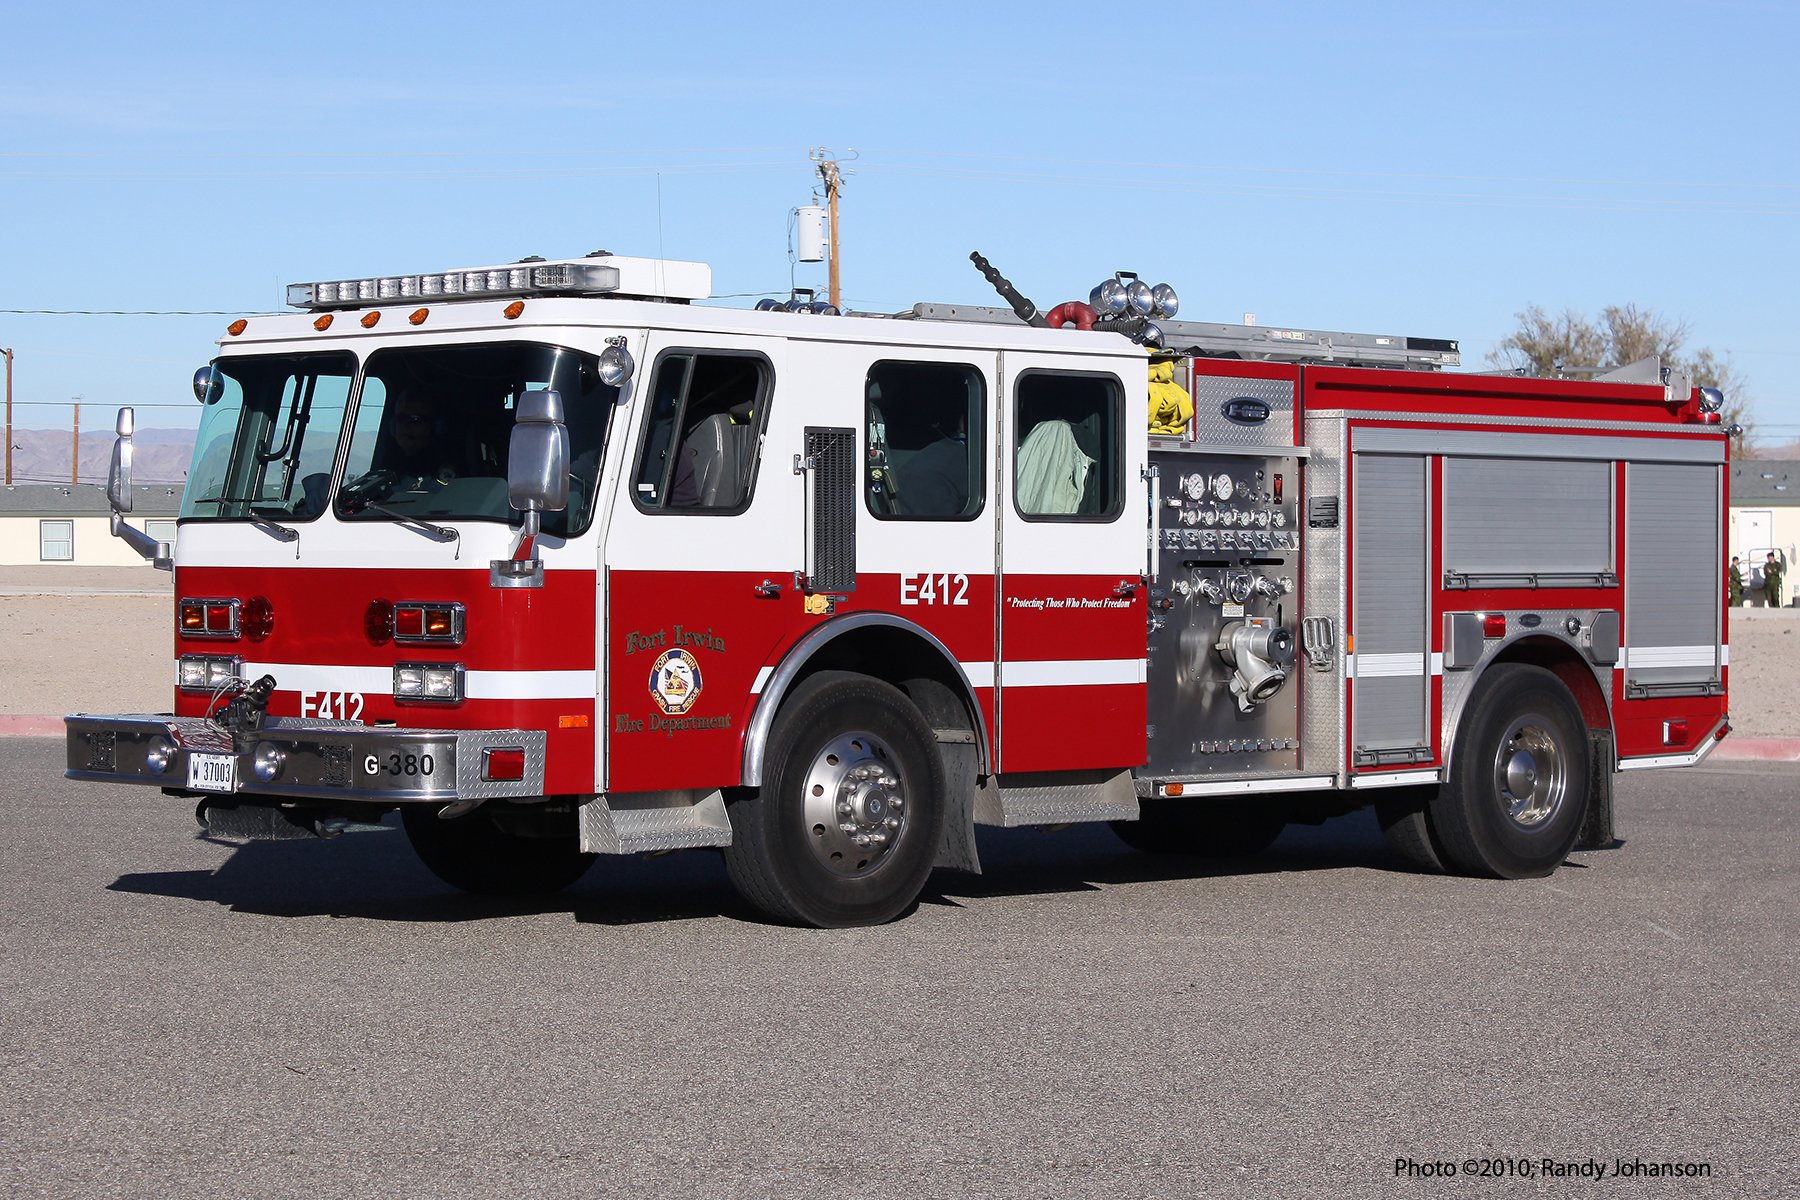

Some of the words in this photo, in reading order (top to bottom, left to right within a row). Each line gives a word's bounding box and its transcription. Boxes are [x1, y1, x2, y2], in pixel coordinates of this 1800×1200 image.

[900, 573, 969, 605] E412
[1046, 597, 1065, 608] Those
[1065, 597, 1080, 608] Who
[1080, 597, 1103, 608] Protect
[625, 629, 667, 655] Fort
[673, 625, 726, 653] Irwin
[654, 652, 670, 672] FORT
[680, 652, 697, 670] IRWIN
[652, 689, 668, 709] CRASH
[682, 687, 700, 710] RESCUE
[615, 713, 644, 733] Fire
[648, 713, 732, 738] Department
[193, 761, 199, 780] W
[203, 762, 231, 783] 37003
[363, 753, 434, 776] G-380
